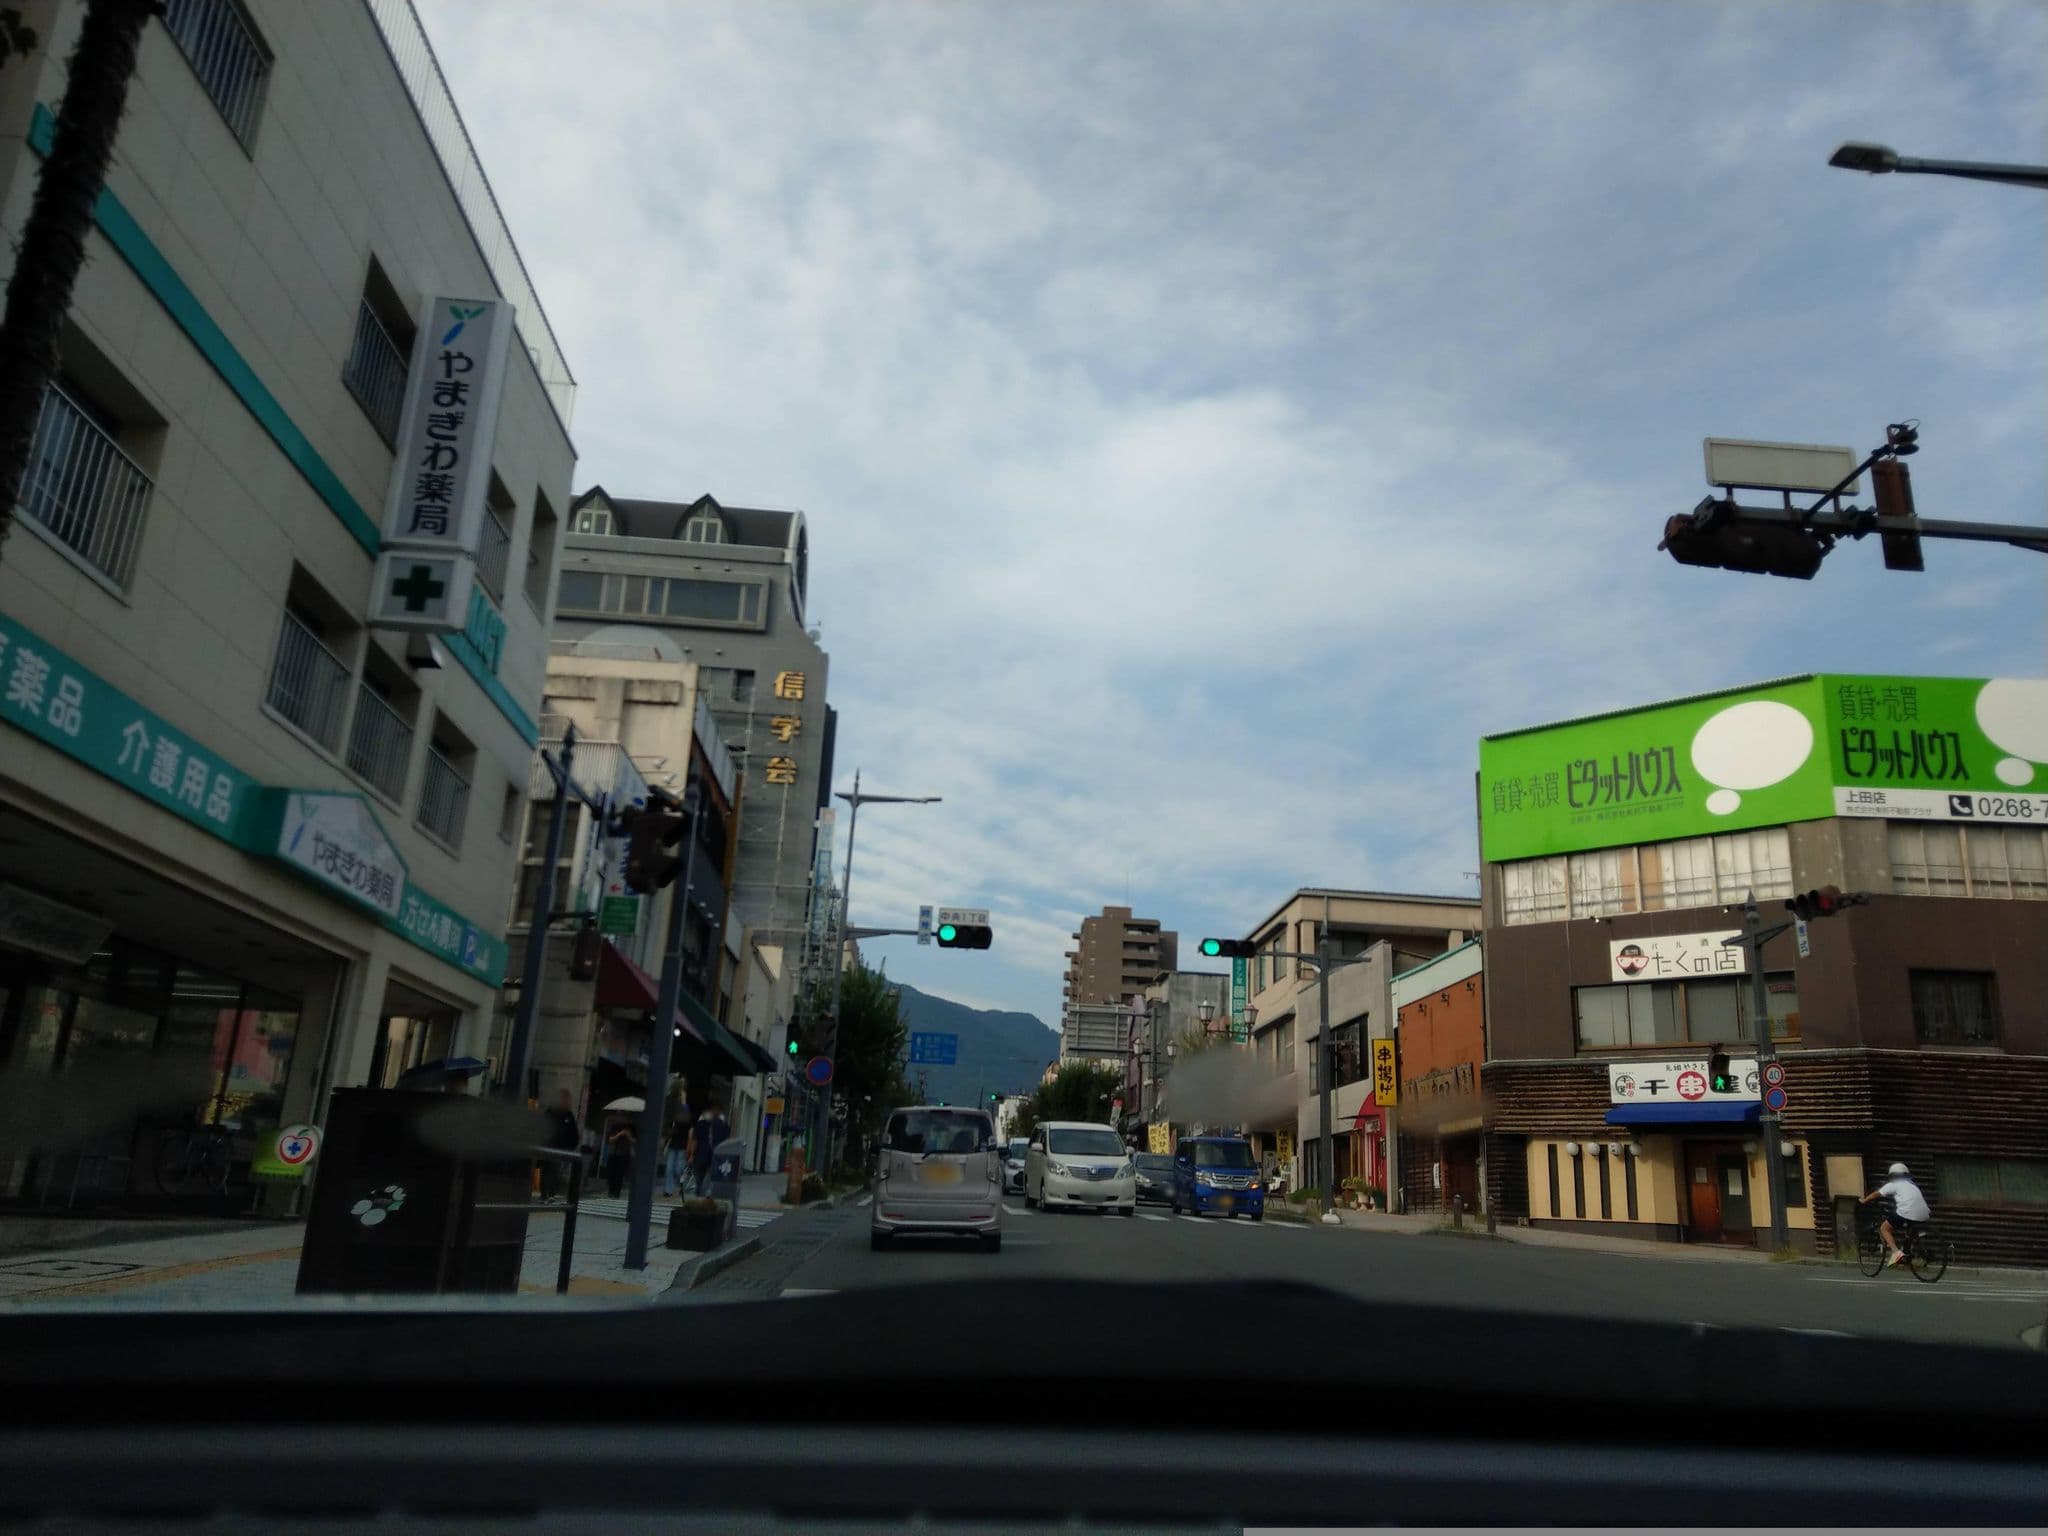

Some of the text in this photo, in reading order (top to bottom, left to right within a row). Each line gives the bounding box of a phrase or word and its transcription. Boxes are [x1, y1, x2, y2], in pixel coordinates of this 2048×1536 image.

[408, 349, 474, 535] やまぎわ薬局
[0, 632, 232, 824] 薬品 介護用品
[1840, 726, 1970, 780] ピタットハウス
[1566, 745, 1683, 809] ピタットハウス
[1846, 790, 1886, 805] 上田店
[312, 830, 396, 909] やまぎわ薬局
[1651, 948, 1738, 976] たくの店
[1377, 1045, 1395, 1096] 串揚げ
[1665, 1062, 1706, 1072] 元祖やきと
[1768, 1070, 1780, 1081] 40
